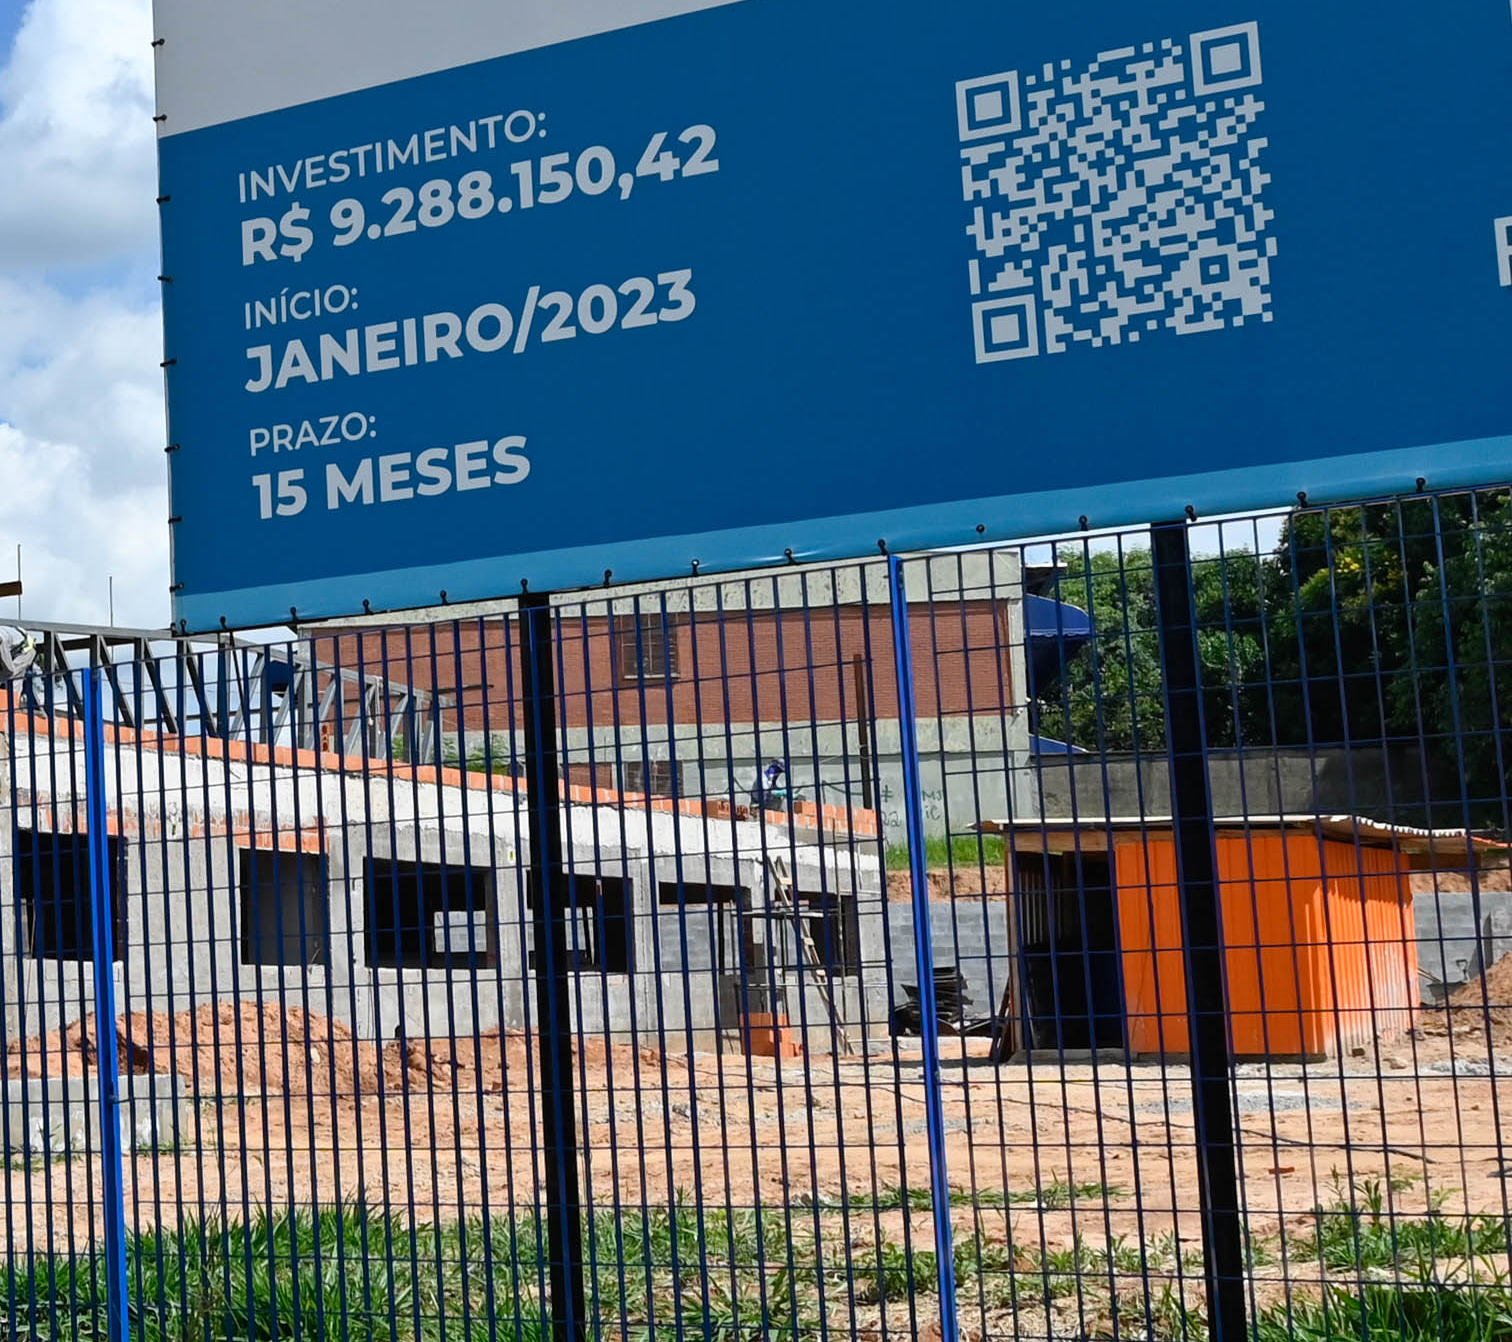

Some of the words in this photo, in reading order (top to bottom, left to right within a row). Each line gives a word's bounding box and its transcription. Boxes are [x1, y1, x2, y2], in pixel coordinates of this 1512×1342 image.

[238, 109, 547, 204] INVESTIMENTO:
[240, 199, 314, 266] R$
[328, 124, 720, 247] 9.288.150,42
[243, 282, 359, 330] INÍCIO:
[244, 268, 697, 393] JANEIRO/2023
[249, 411, 377, 457] PRAZO:
[252, 467, 309, 520] 15
[324, 435, 532, 513] MESES
